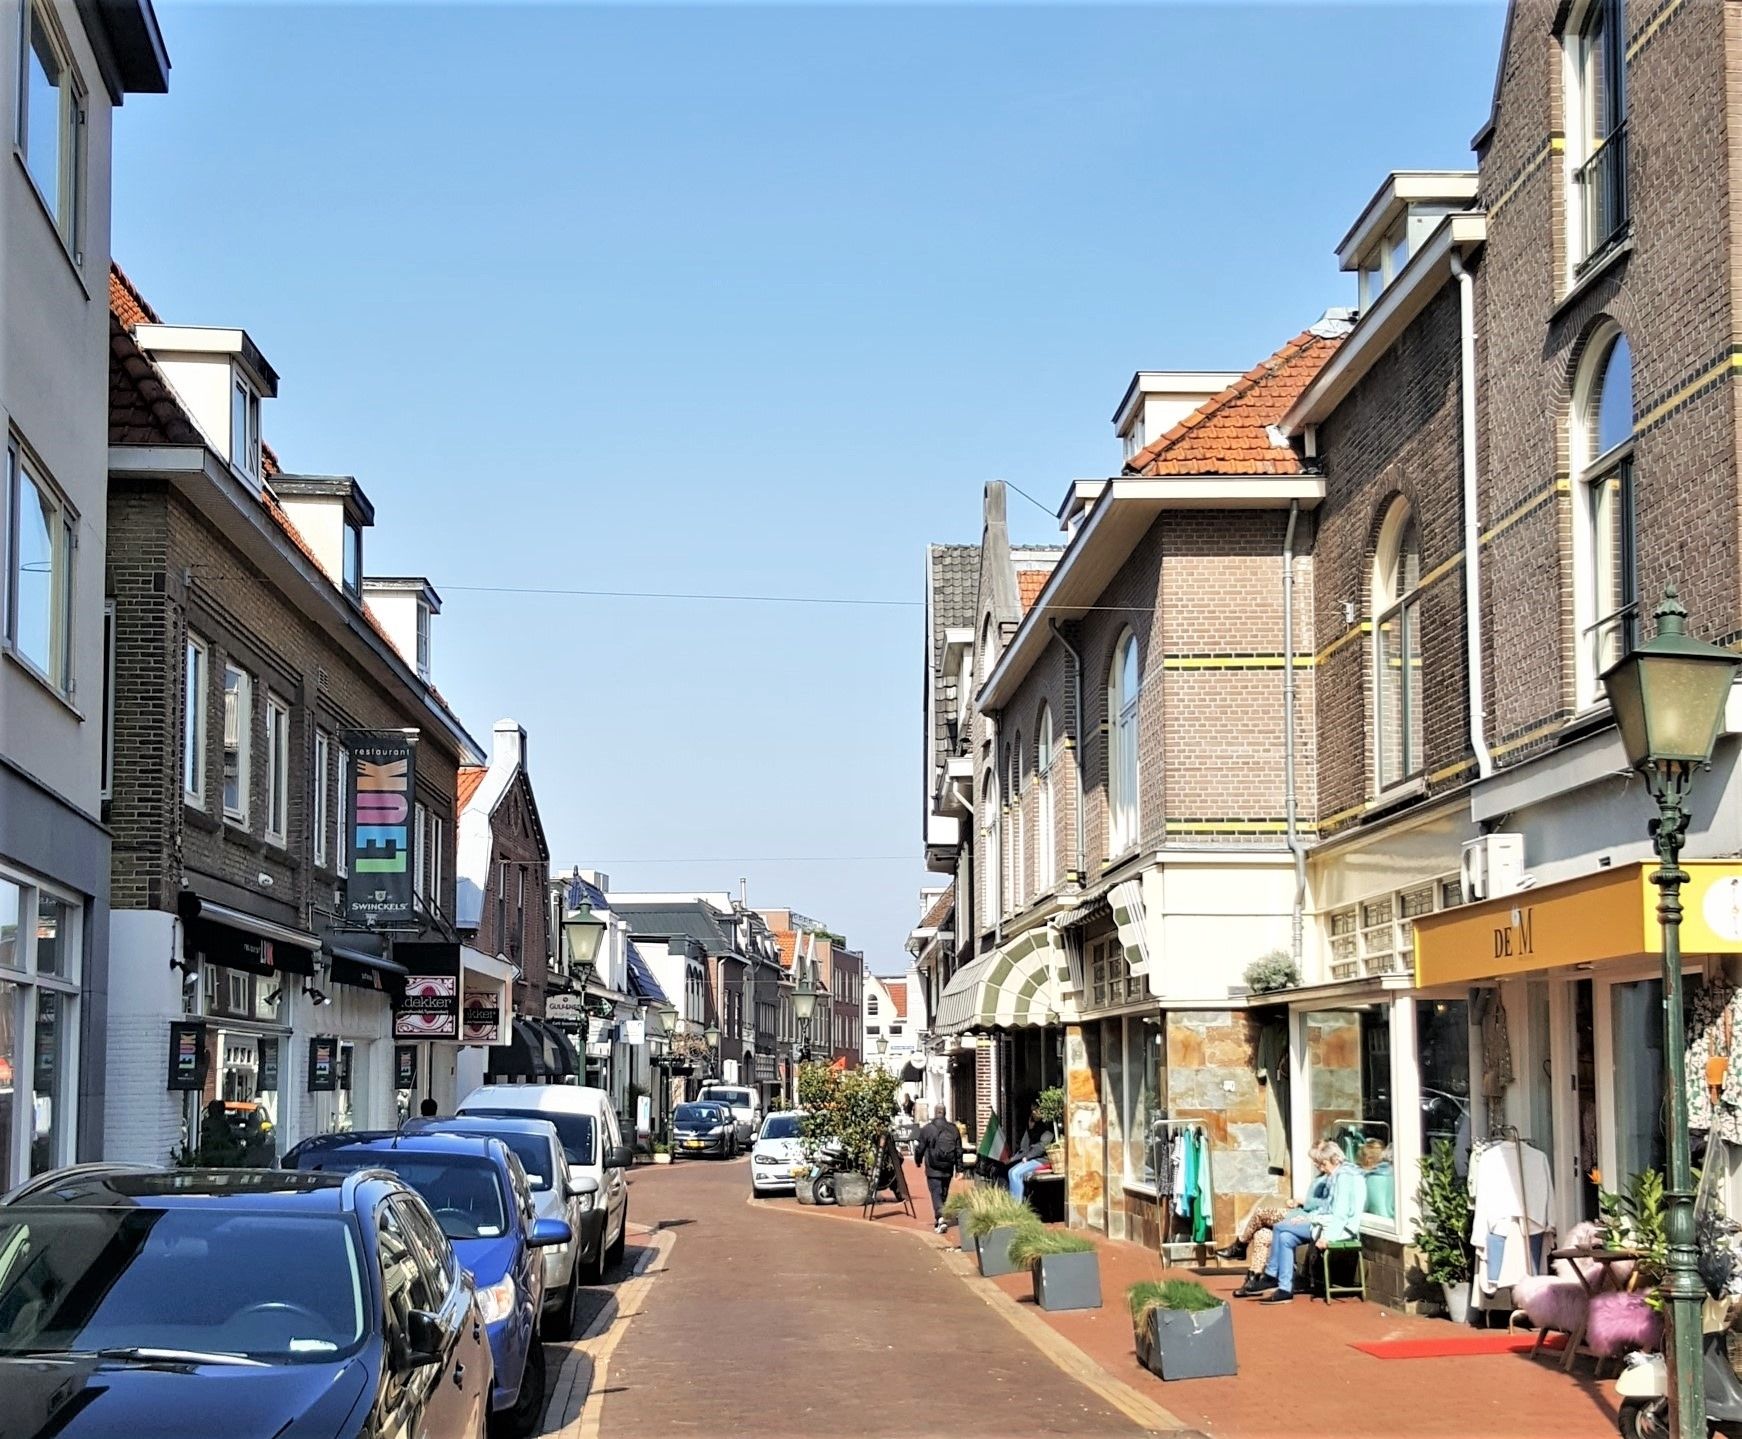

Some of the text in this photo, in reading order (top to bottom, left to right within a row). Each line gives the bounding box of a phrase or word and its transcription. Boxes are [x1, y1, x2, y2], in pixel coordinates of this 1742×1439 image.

[354, 748, 410, 756] restaurant
[356, 758, 409, 873] LEUK
[1494, 907, 1533, 959] DE M
